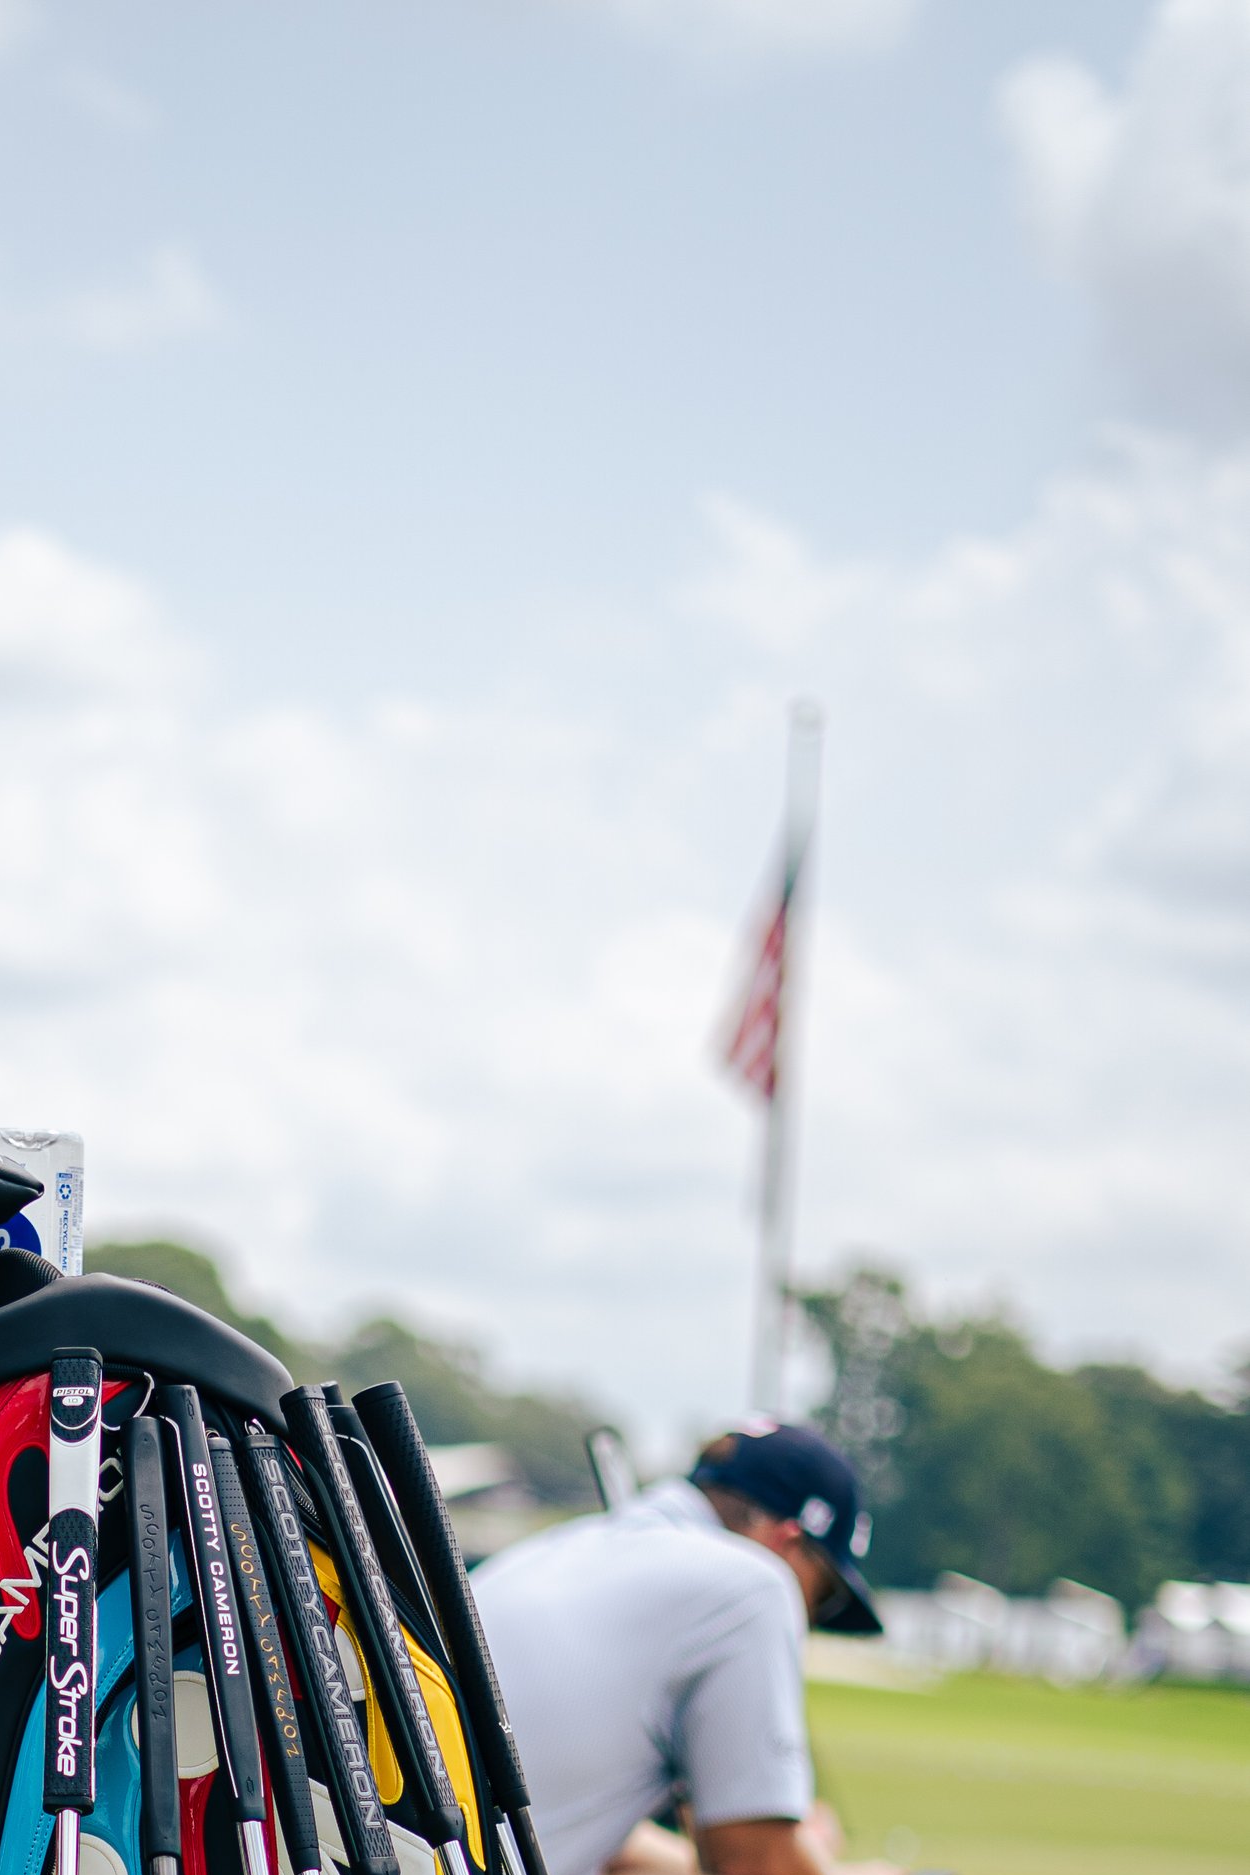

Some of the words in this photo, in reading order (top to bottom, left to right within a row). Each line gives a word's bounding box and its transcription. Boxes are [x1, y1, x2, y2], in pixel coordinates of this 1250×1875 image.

[61, 1210, 69, 1252] RECYCLE
[61, 1256, 68, 1271] ME
[56, 1388, 91, 1396] PISTOL
[139, 1503, 165, 1599] SCOTTY
[192, 1463, 221, 1552] SCOTTY
[209, 1561, 240, 1675] CAMERON
[230, 1523, 271, 1628] SCOTTY
[260, 1638, 300, 1758] CAMERON
[262, 1458, 324, 1621] SCOTTY
[310, 1624, 381, 1829] CAMERON
